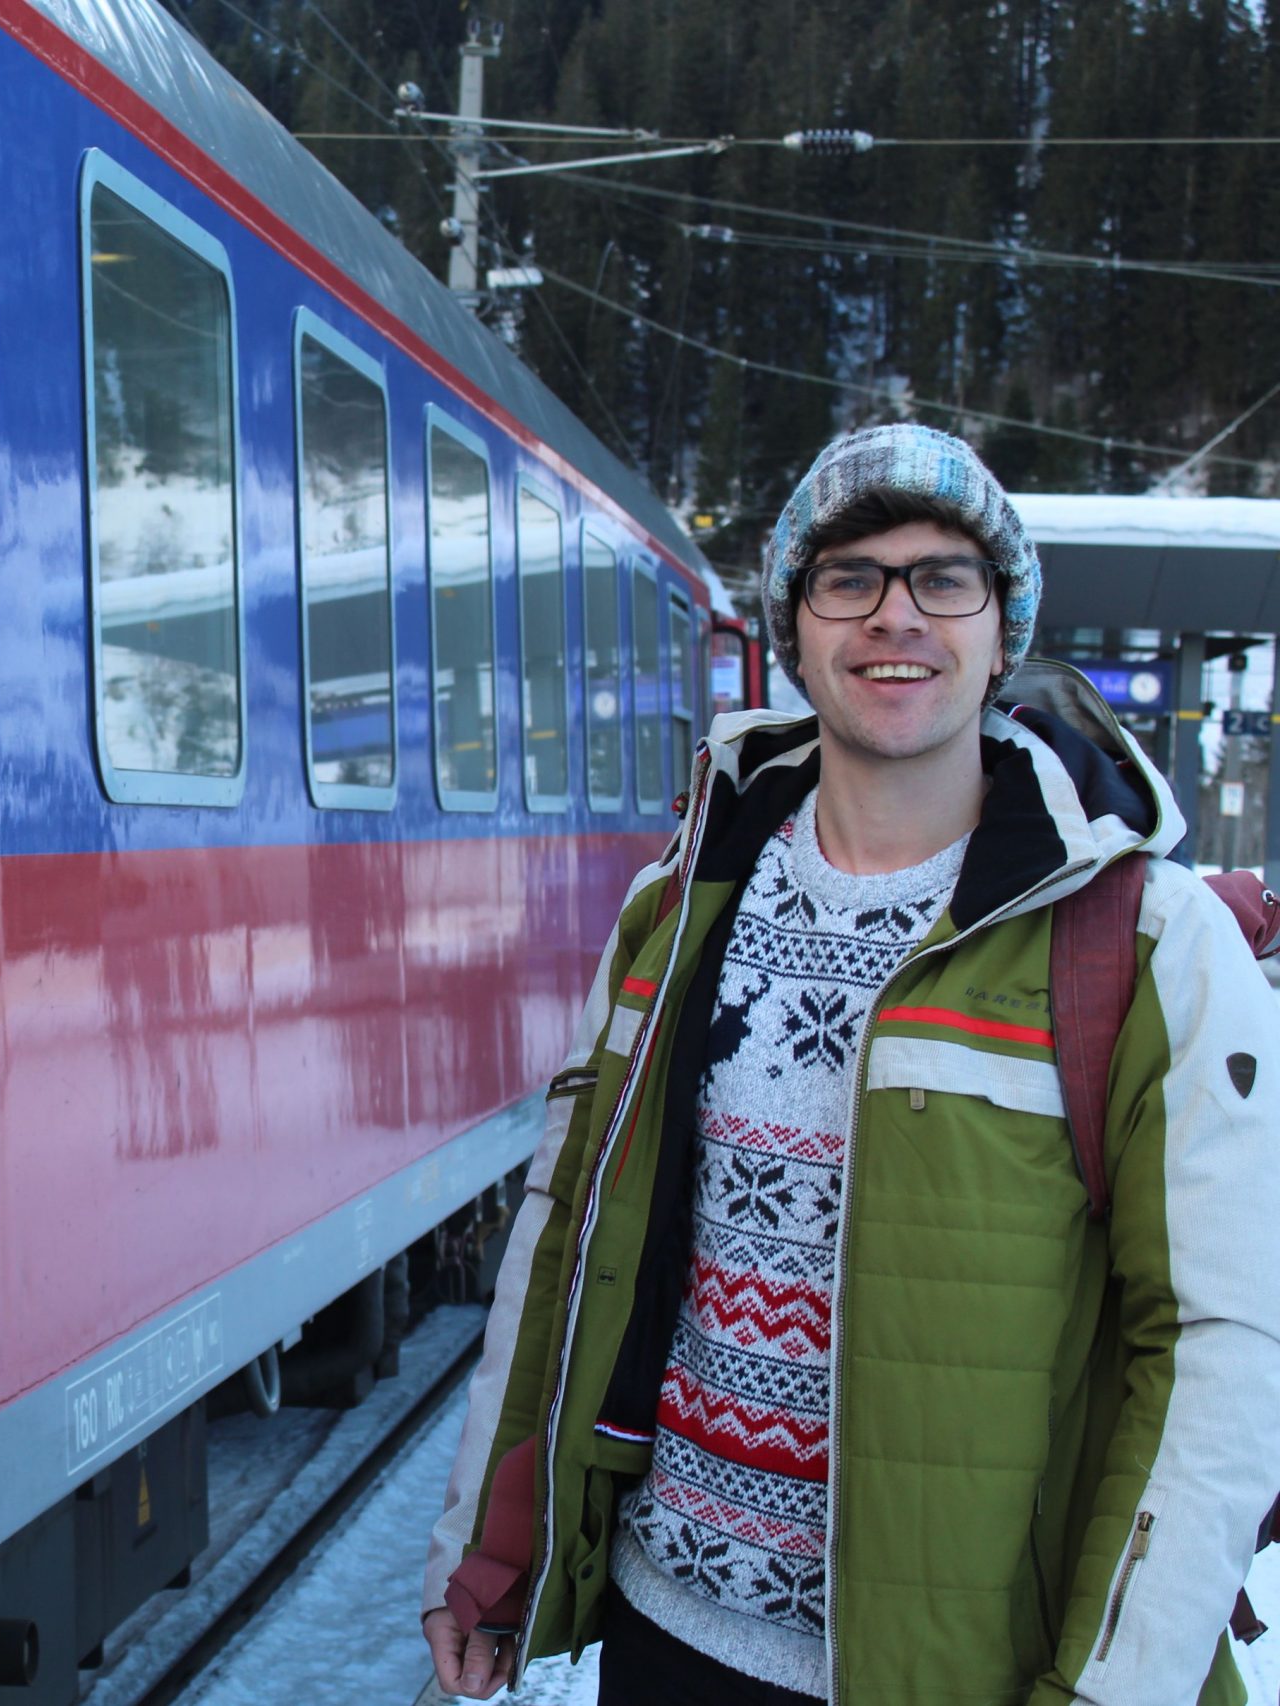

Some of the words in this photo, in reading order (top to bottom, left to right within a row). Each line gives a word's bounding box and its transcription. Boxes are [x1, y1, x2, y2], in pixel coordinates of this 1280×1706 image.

[1229, 712, 1242, 733] 2
[73, 1387, 98, 1453] 160
[106, 1371, 124, 1431] RIC
